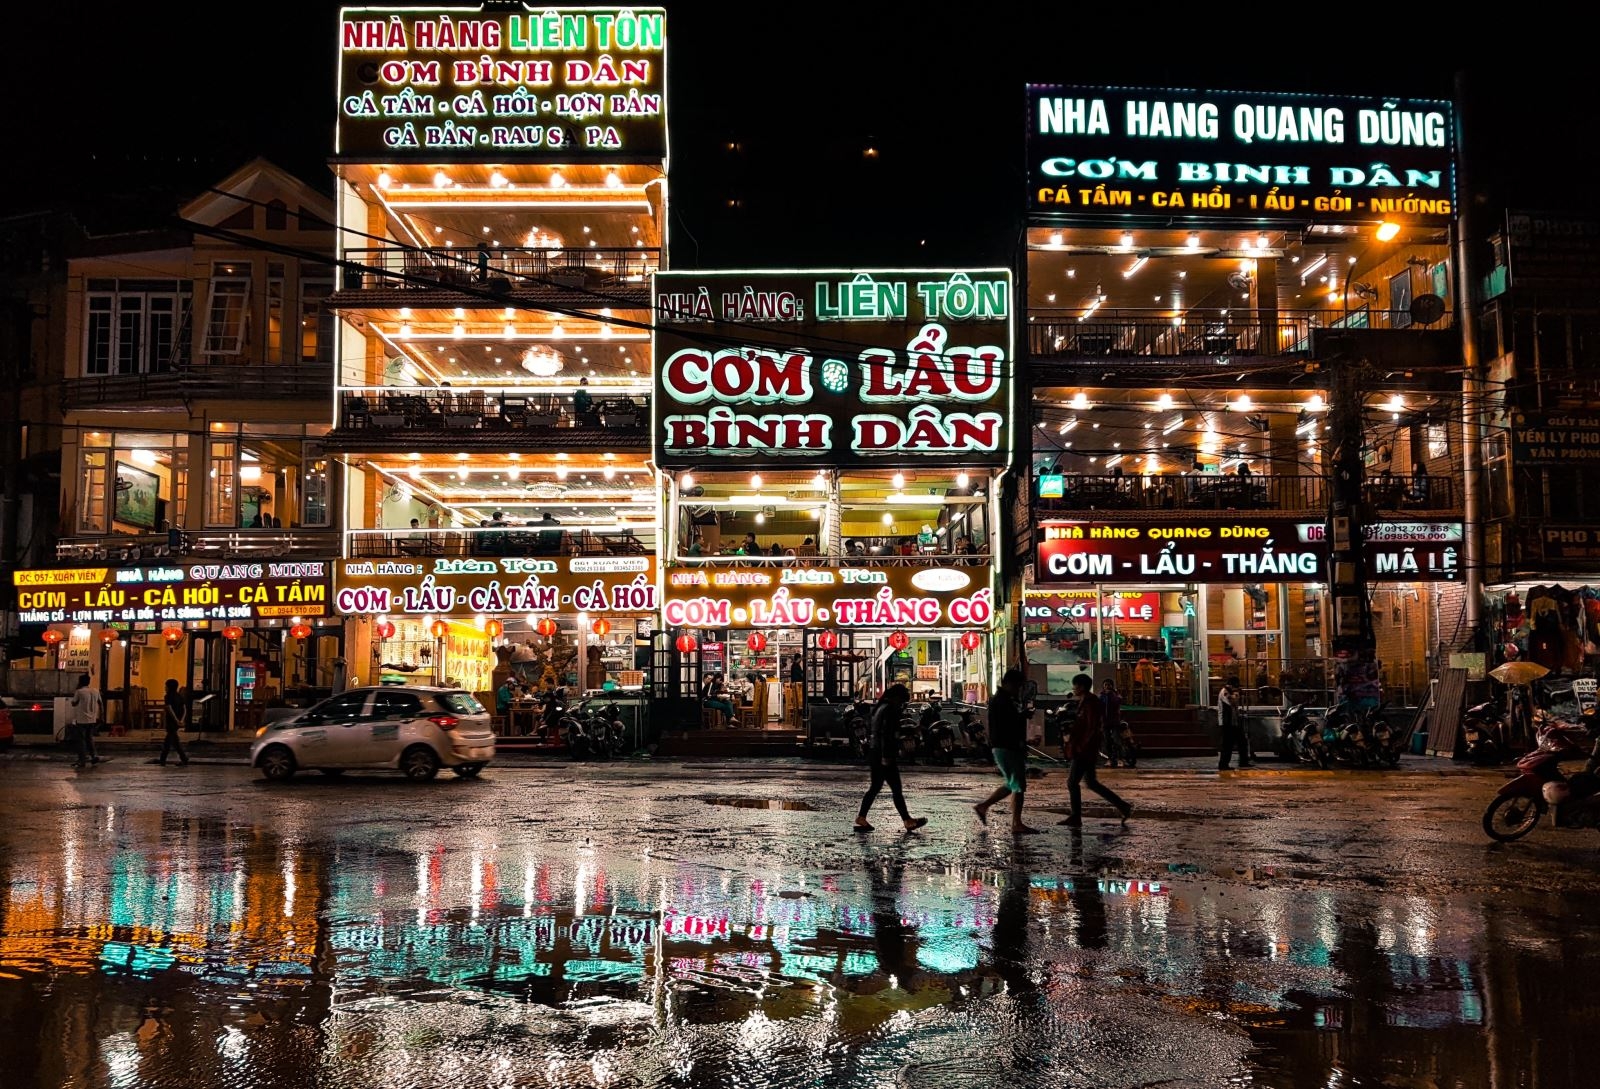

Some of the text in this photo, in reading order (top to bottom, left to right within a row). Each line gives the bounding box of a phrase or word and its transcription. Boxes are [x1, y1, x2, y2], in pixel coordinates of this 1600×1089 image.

[343, 9, 663, 50] NHÀ HÀNG LIÊN TÔN
[454, 55, 553, 85] BÌNH
[565, 54, 649, 84] DÂN
[344, 87, 661, 120] CÁ TẦM CÁ HỒI LỢN BẢN
[384, 120, 621, 147] GÀ BẢN RAU SA PA
[1233, 104, 1344, 144] QUANG
[1358, 103, 1445, 147] DŨNG
[1040, 156, 1158, 180] CƠM
[1330, 162, 1441, 188] DÂN
[1038, 184, 1071, 205] CÁ
[1079, 184, 1132, 206] TẦM
[1192, 185, 1231, 209] HỒI
[1314, 189, 1351, 212] GỎI
[658, 286, 714, 321] NHÀ
[815, 272, 908, 321] LIÊN
[918, 272, 1007, 321] TÔN
[663, 323, 1004, 404] CƠM LẨU
[664, 405, 1003, 454] BÌNH DÂN
[1550, 431, 1566, 443] LY
[1046, 525, 1270, 539] NHÀ HÀNG QUANG DŨNG
[1547, 530, 1588, 542] PHO
[190, 564, 263, 579] QUANG
[269, 562, 324, 577] MINH
[346, 562, 373, 575] NHÀ
[434, 558, 497, 574] Liên
[501, 557, 558, 573] Tôn
[1048, 552, 1113, 575] CƠM
[1140, 541, 1195, 575] LẨU
[1222, 539, 1317, 574] THẮNG
[1376, 547, 1419, 574] MÃ
[19, 579, 325, 608] CƠM LẨU CÁ HỒI CÁ TẦM
[338, 573, 657, 613] CƠM LẨU CÁ TẦM CÁ HỒI
[665, 586, 993, 625] CƠM LẨU THẮNG CỐ
[1129, 604, 1153, 621] LỆ
